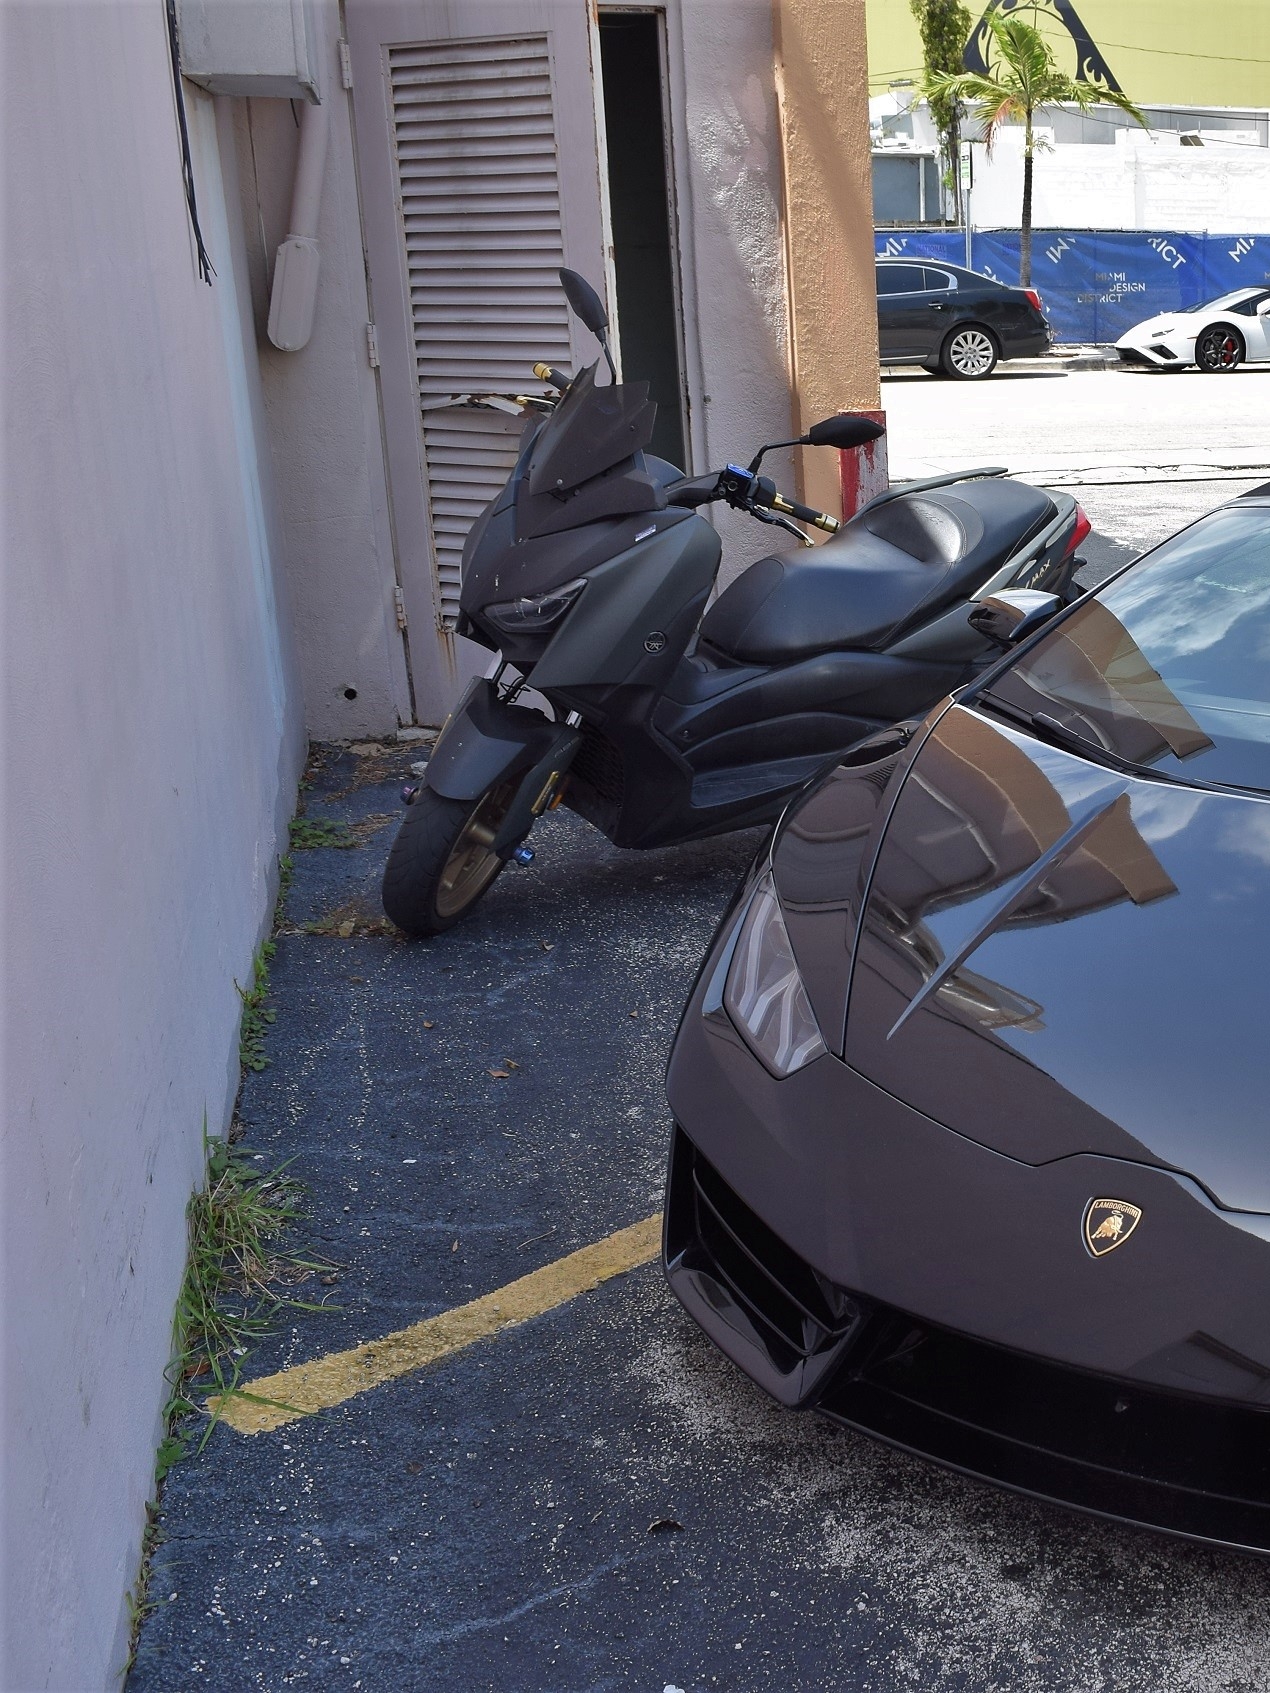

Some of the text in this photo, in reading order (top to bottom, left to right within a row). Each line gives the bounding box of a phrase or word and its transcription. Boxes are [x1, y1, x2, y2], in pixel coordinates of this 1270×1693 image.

[1095, 272, 1126, 281] MIAMI
[1110, 283, 1146, 292] DESIGN
[1078, 294, 1122, 303] DISTRICT
[1095, 1202, 1138, 1218] LAMBORGHINI
